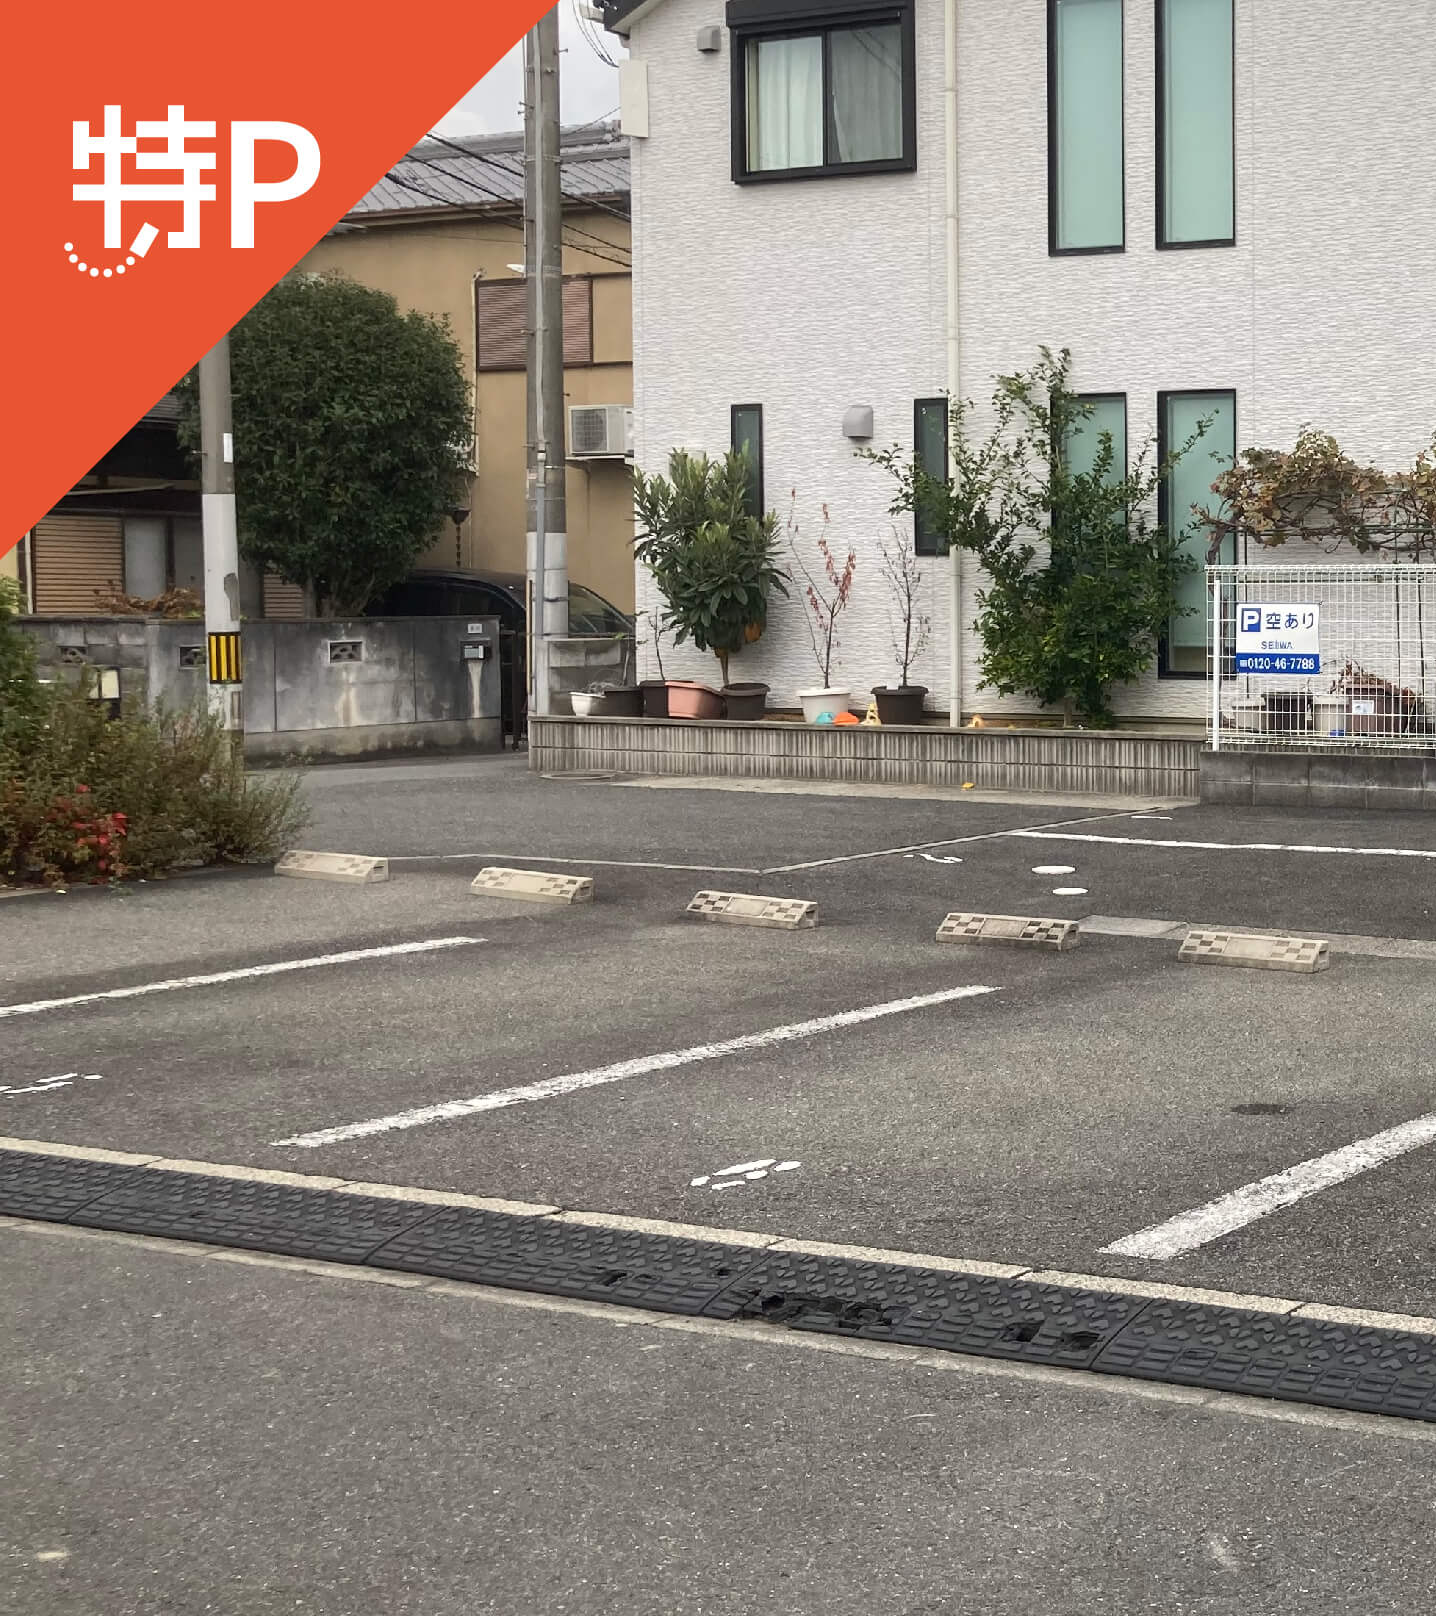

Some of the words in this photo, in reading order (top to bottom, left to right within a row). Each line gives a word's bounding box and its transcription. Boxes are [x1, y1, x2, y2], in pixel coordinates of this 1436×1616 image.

[1243, 610, 1260, 631] P
[1265, 612, 1314, 630] 空あり
[1247, 657, 1315, 670] 0120-46-7788
